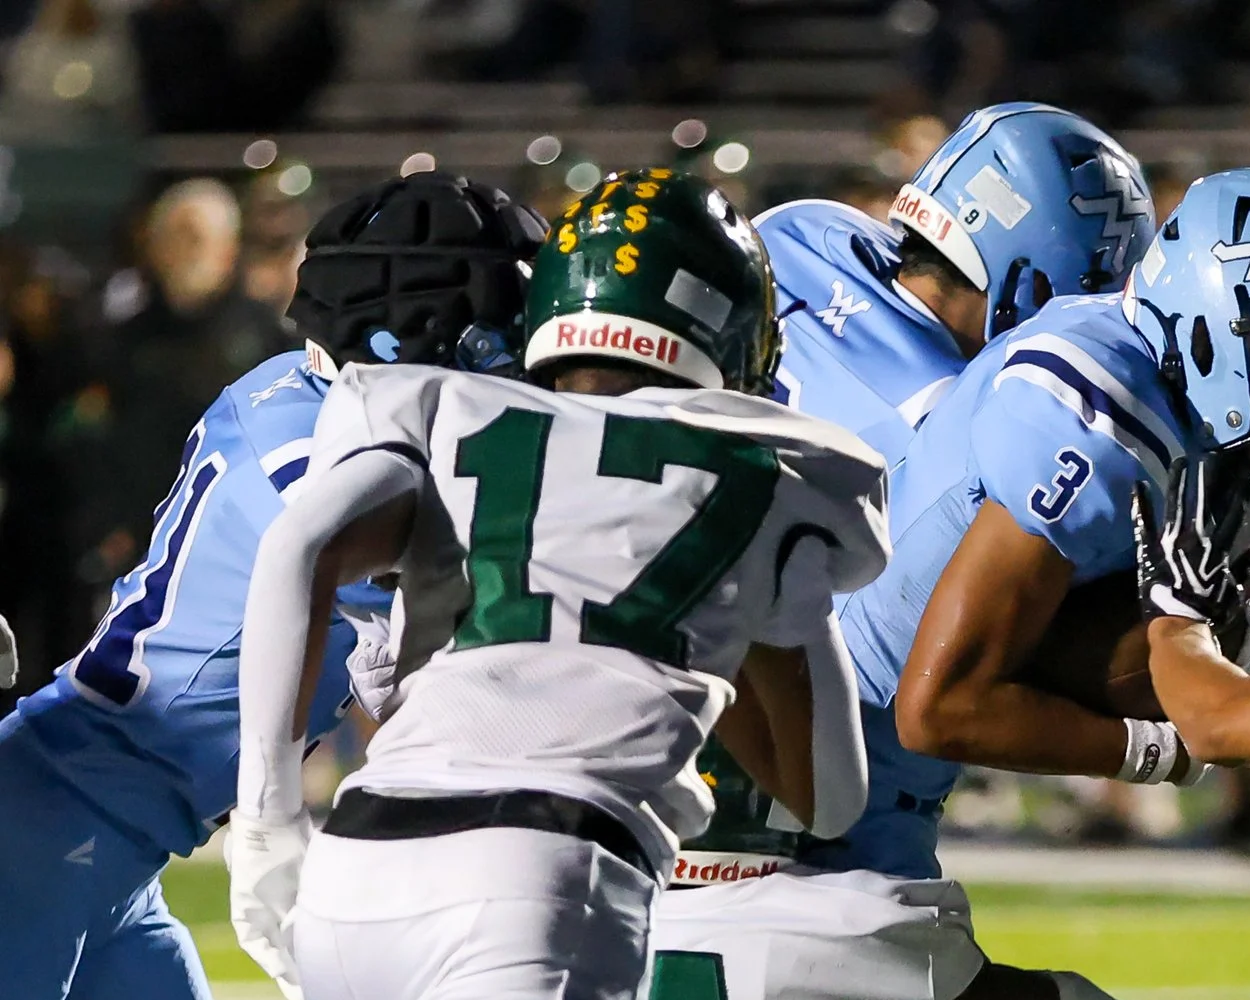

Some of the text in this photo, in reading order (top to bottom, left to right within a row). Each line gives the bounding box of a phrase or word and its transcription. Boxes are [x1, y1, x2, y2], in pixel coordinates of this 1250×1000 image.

[964, 208, 980, 225] 9
[556, 322, 682, 365] Riddell
[1027, 446, 1094, 524] 3
[454, 405, 782, 670] 17
